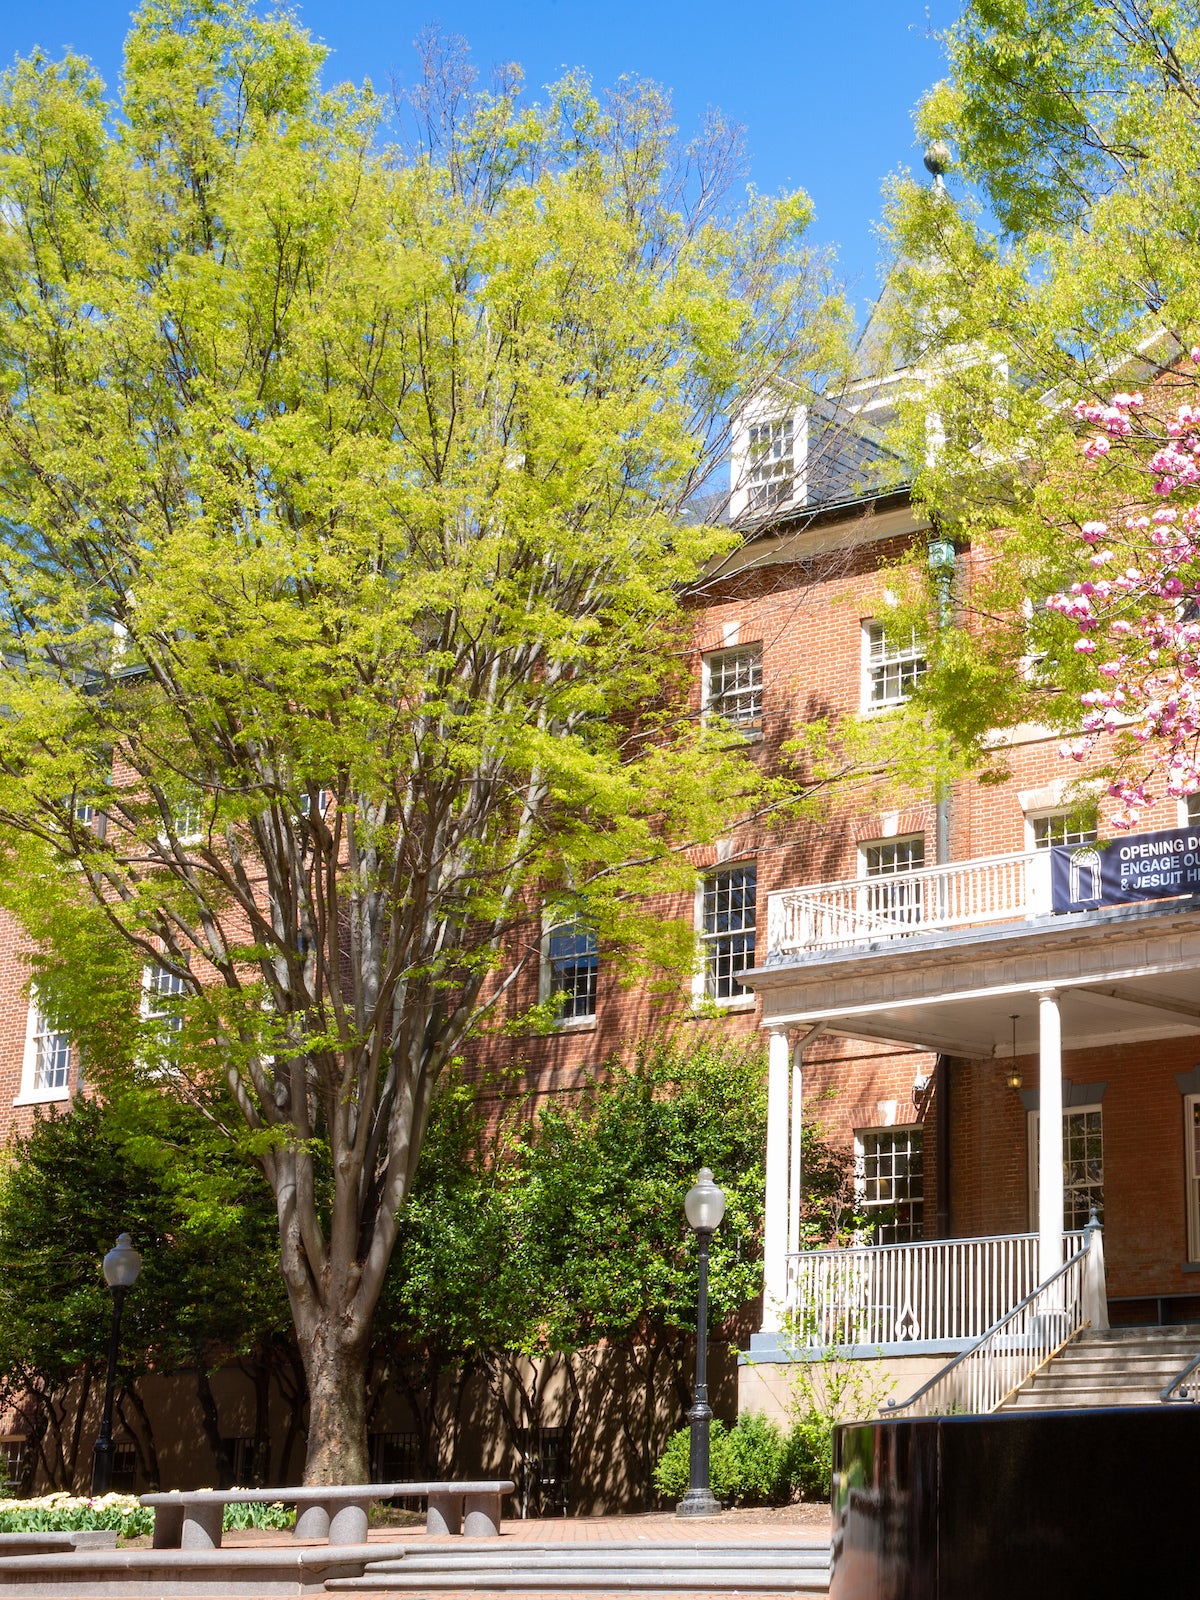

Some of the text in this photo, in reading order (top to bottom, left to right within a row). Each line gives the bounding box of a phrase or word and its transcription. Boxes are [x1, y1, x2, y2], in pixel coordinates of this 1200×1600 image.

[1120, 838, 1184, 860] OPENING
[1121, 855, 1180, 876] ENGAGE
[1121, 879, 1130, 891] &
[1133, 871, 1183, 889] JESUIT
